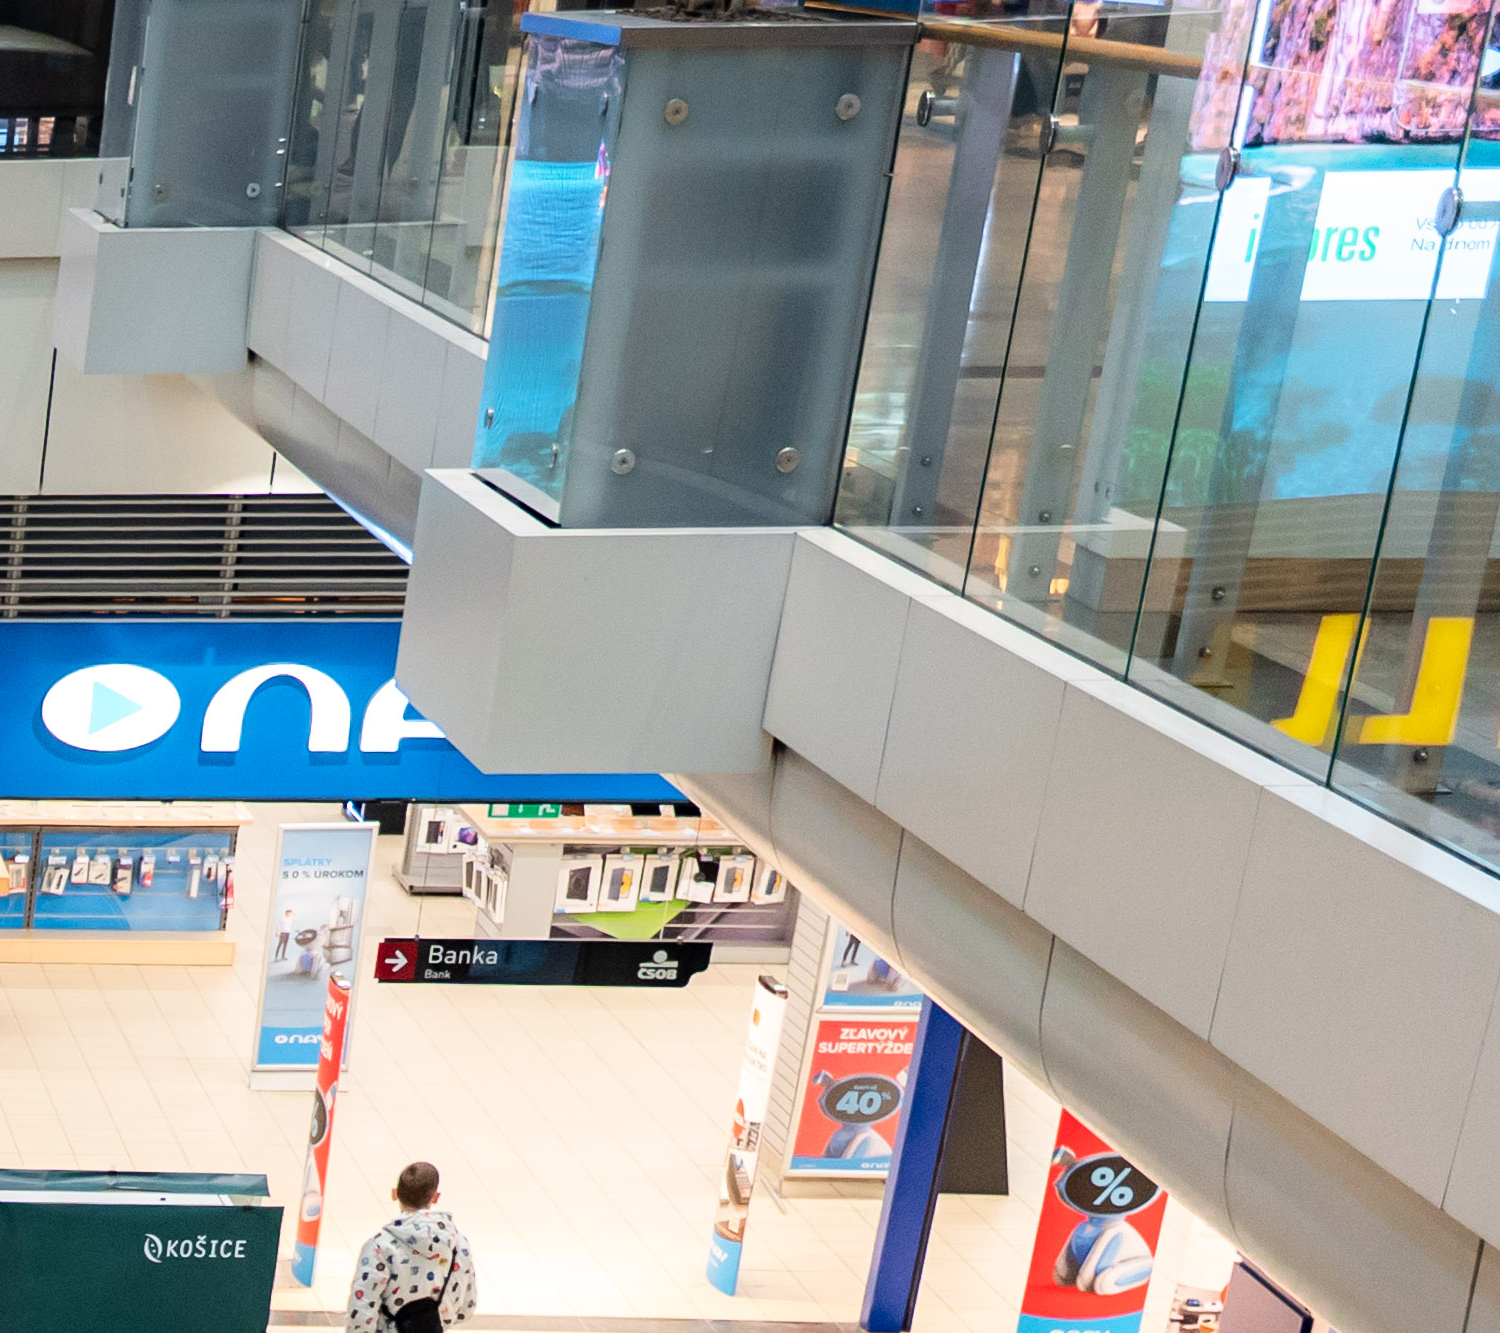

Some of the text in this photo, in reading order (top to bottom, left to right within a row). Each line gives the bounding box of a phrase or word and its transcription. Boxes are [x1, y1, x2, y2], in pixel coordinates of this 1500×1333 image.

[428, 945, 498, 966] Banka
[424, 969, 451, 979] Bank
[637, 966, 677, 980] ČSOB
[839, 1027, 908, 1041] ZĽAVOVÝ
[818, 1042, 914, 1055] SUPERTÝŽDE
[836, 1090, 883, 1115] 40
[166, 1234, 247, 1259] KOŠICE
